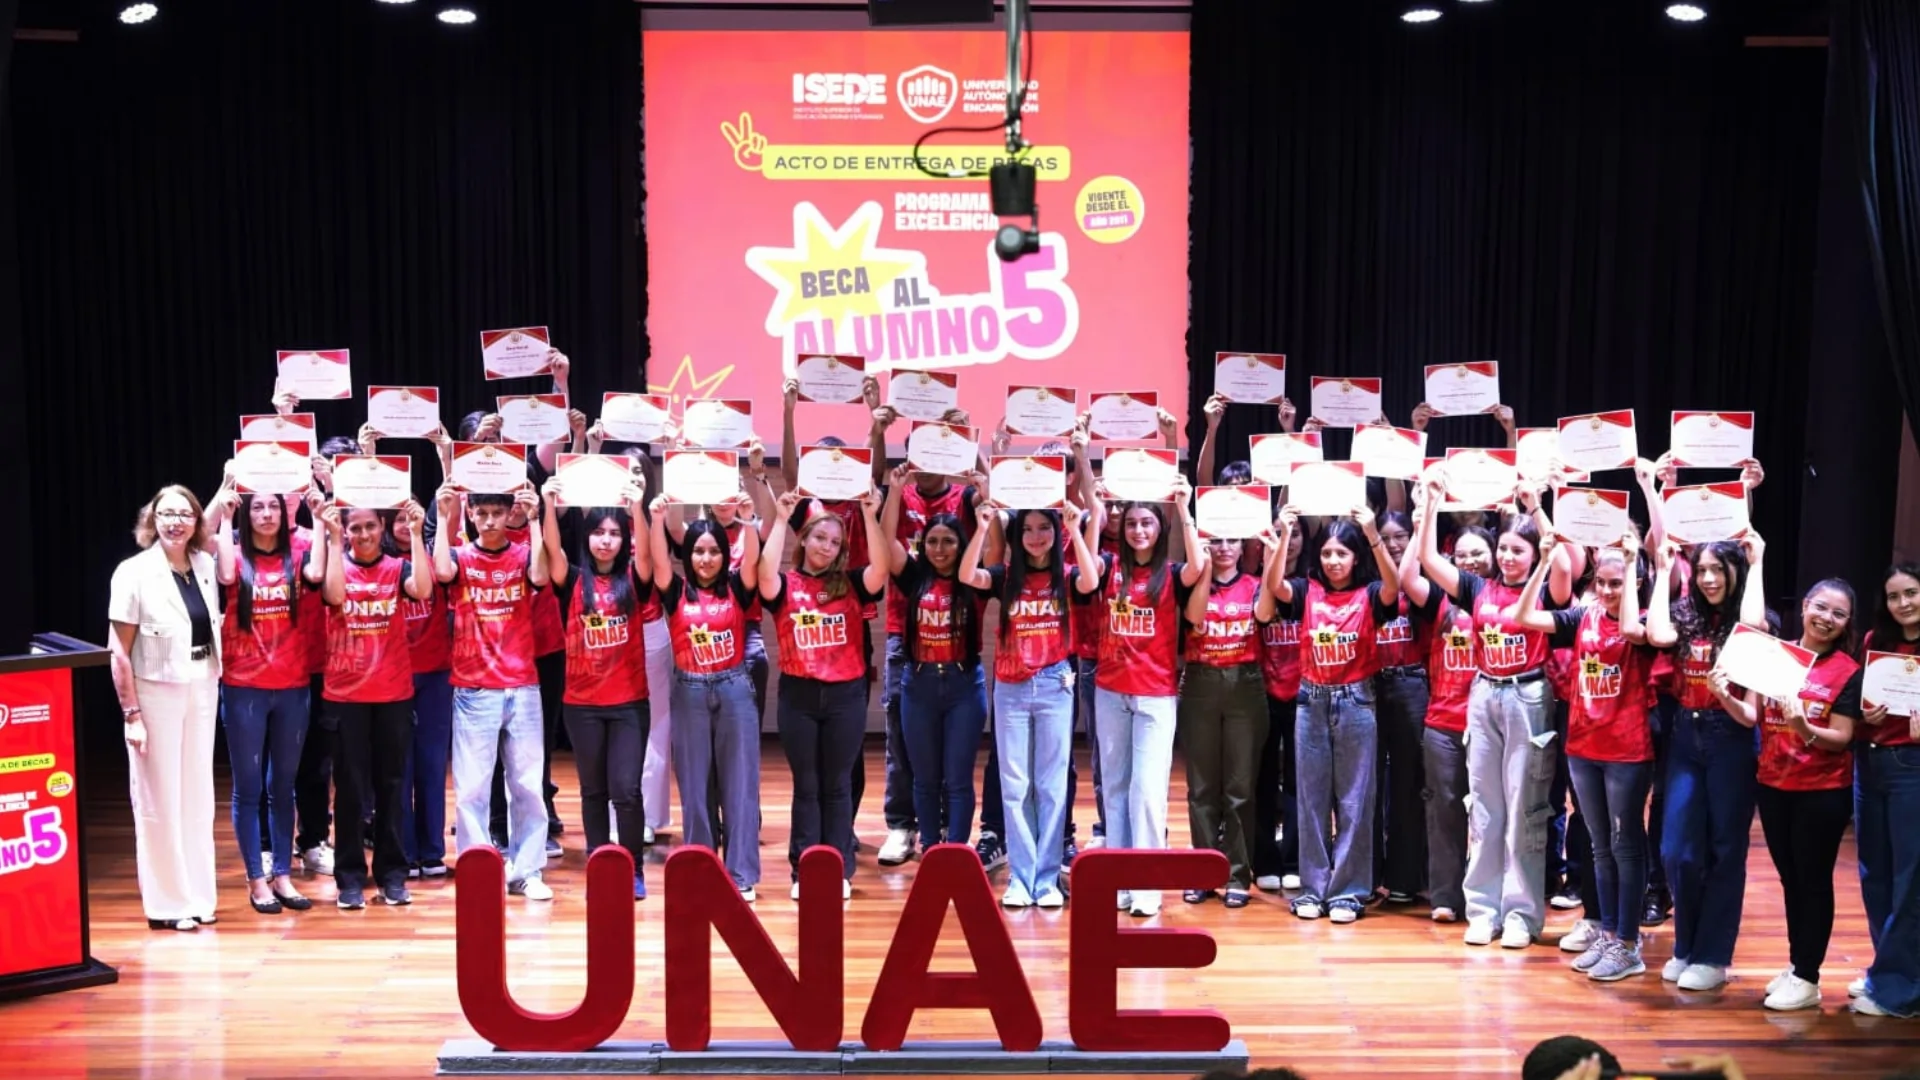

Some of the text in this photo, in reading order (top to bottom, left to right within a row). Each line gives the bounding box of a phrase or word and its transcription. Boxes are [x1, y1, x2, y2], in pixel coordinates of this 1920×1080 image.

[793, 73, 887, 104] ISEDE
[908, 95, 948, 108] UNAE
[775, 156, 828, 170] ACTO
[832, 156, 859, 170] DE
[865, 156, 956, 171] ENTREGA
[961, 157, 987, 170] DE
[895, 192, 991, 211] PROGRAMA
[1088, 190, 1127, 202] VIGENTE
[1086, 199, 1130, 212] DESDE EL
[895, 212, 999, 231] EXCELENCIA
[800, 266, 871, 299] BECA
[894, 276, 931, 308] AL
[794, 245, 1067, 362] ALUMNO 5
[1116, 603, 1127, 613] ES
[591, 617, 602, 627] ES
[803, 615, 815, 625] ES
[1112, 615, 1154, 634] UNAE
[586, 625, 628, 648] UNAE
[695, 631, 731, 644] ES EN LA
[796, 624, 846, 648] UNAE
[1319, 632, 1331, 642] ES
[1337, 635, 1347, 643] EN
[1453, 636, 1466, 646] ES
[1486, 634, 1499, 645] ES
[1515, 636, 1523, 644] LA
[693, 640, 734, 664] UNAE
[1587, 663, 1598, 673] ES
[22, 758, 50, 767] BECAS
[30, 811, 61, 858] 5
[456, 844, 1231, 1052] UNAE
